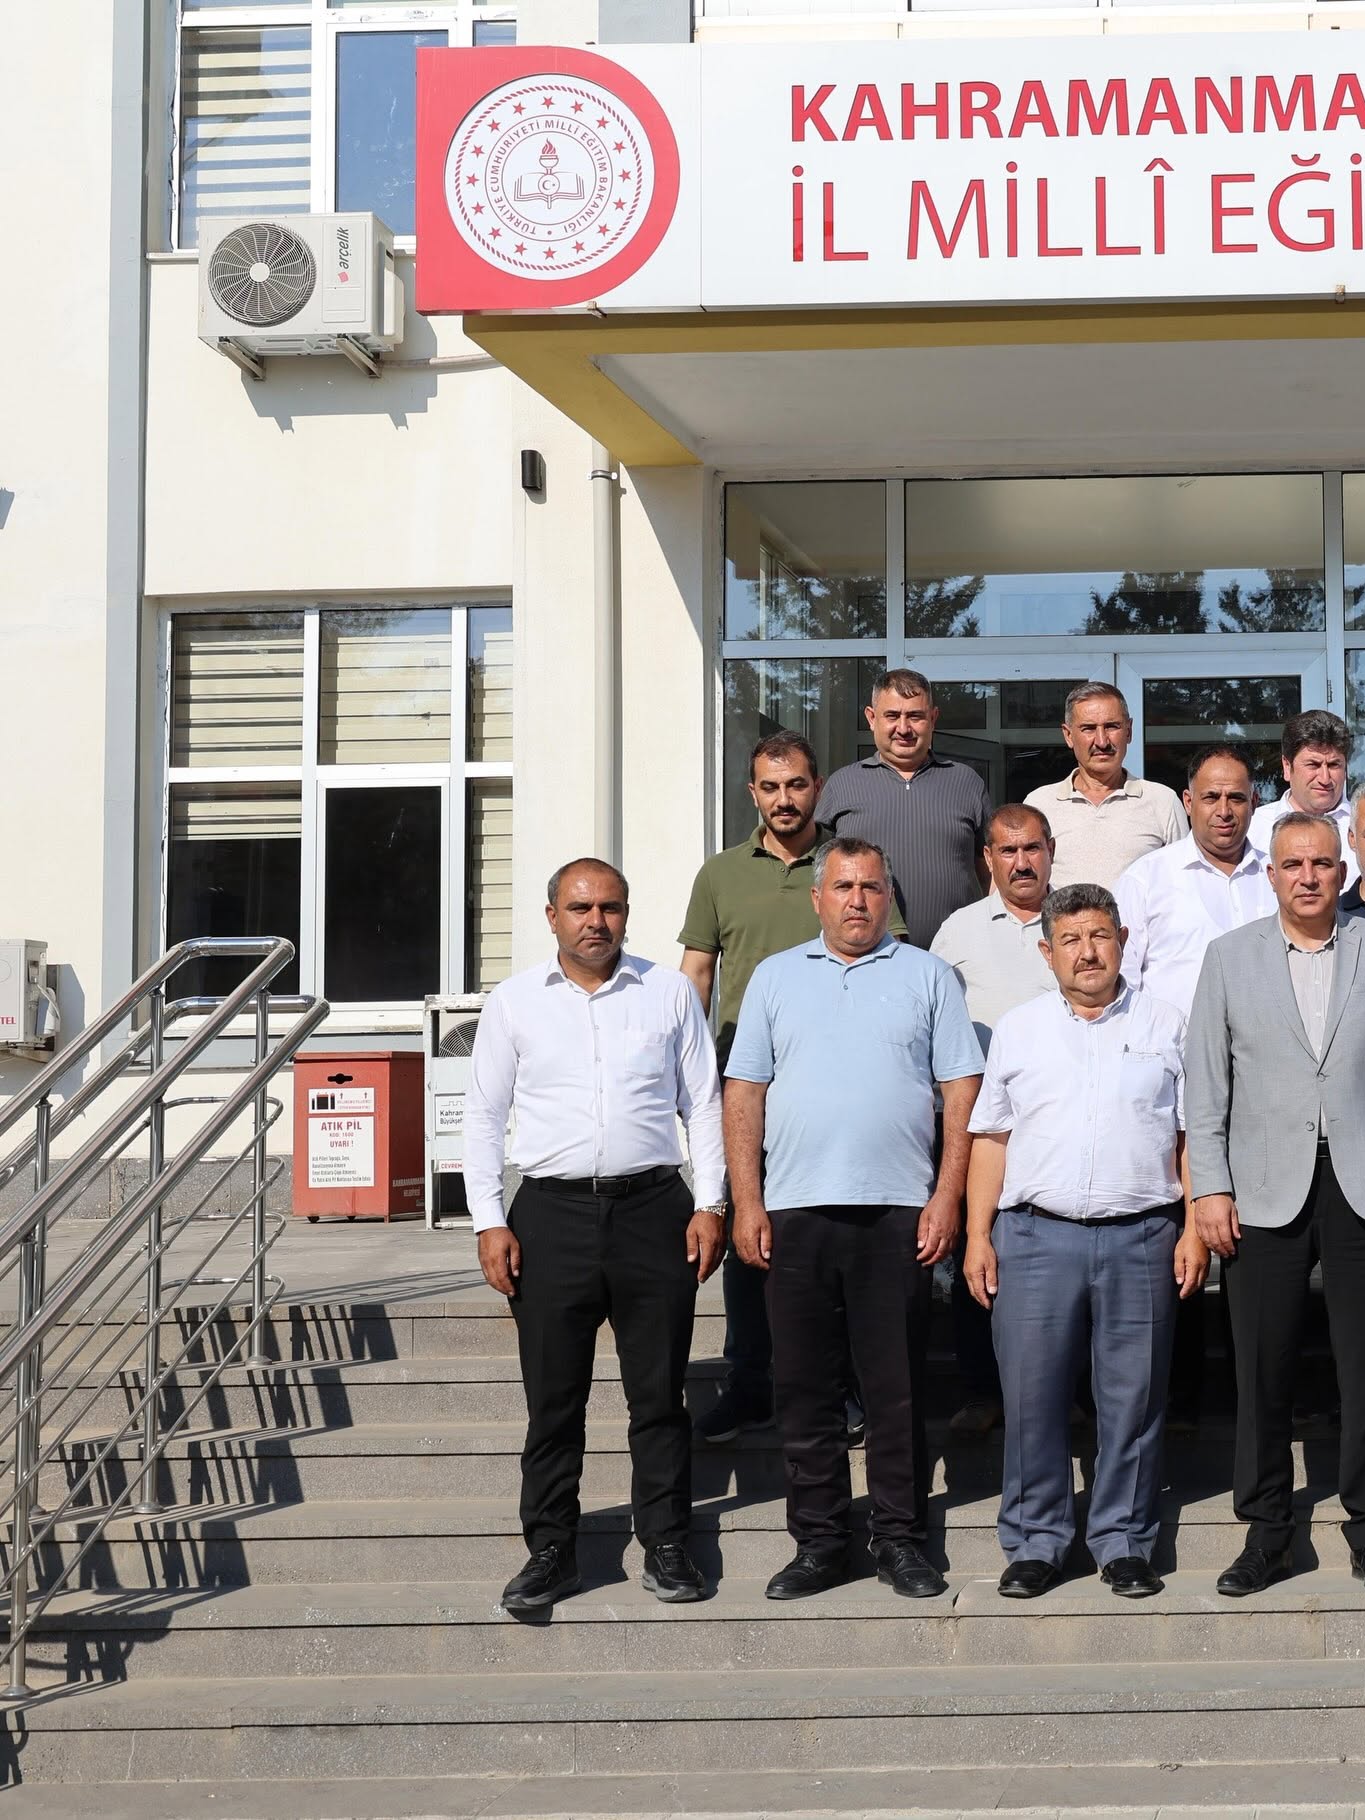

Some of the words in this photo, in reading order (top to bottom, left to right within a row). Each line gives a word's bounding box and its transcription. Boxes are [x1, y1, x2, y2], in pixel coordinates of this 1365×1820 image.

[490, 120, 540, 193] CUMHURİYETİ
[580, 132, 608, 172] EĞİTİM
[563, 177, 608, 234] BAKANLIĞI
[792, 165, 869, 263] İL
[908, 157, 1173, 260] MİLLÎ
[336, 226, 352, 270] arçelik
[0, 1016, 16, 1025] TEL
[321, 1121, 343, 1131] ATIK
[346, 1119, 362, 1131] PİL
